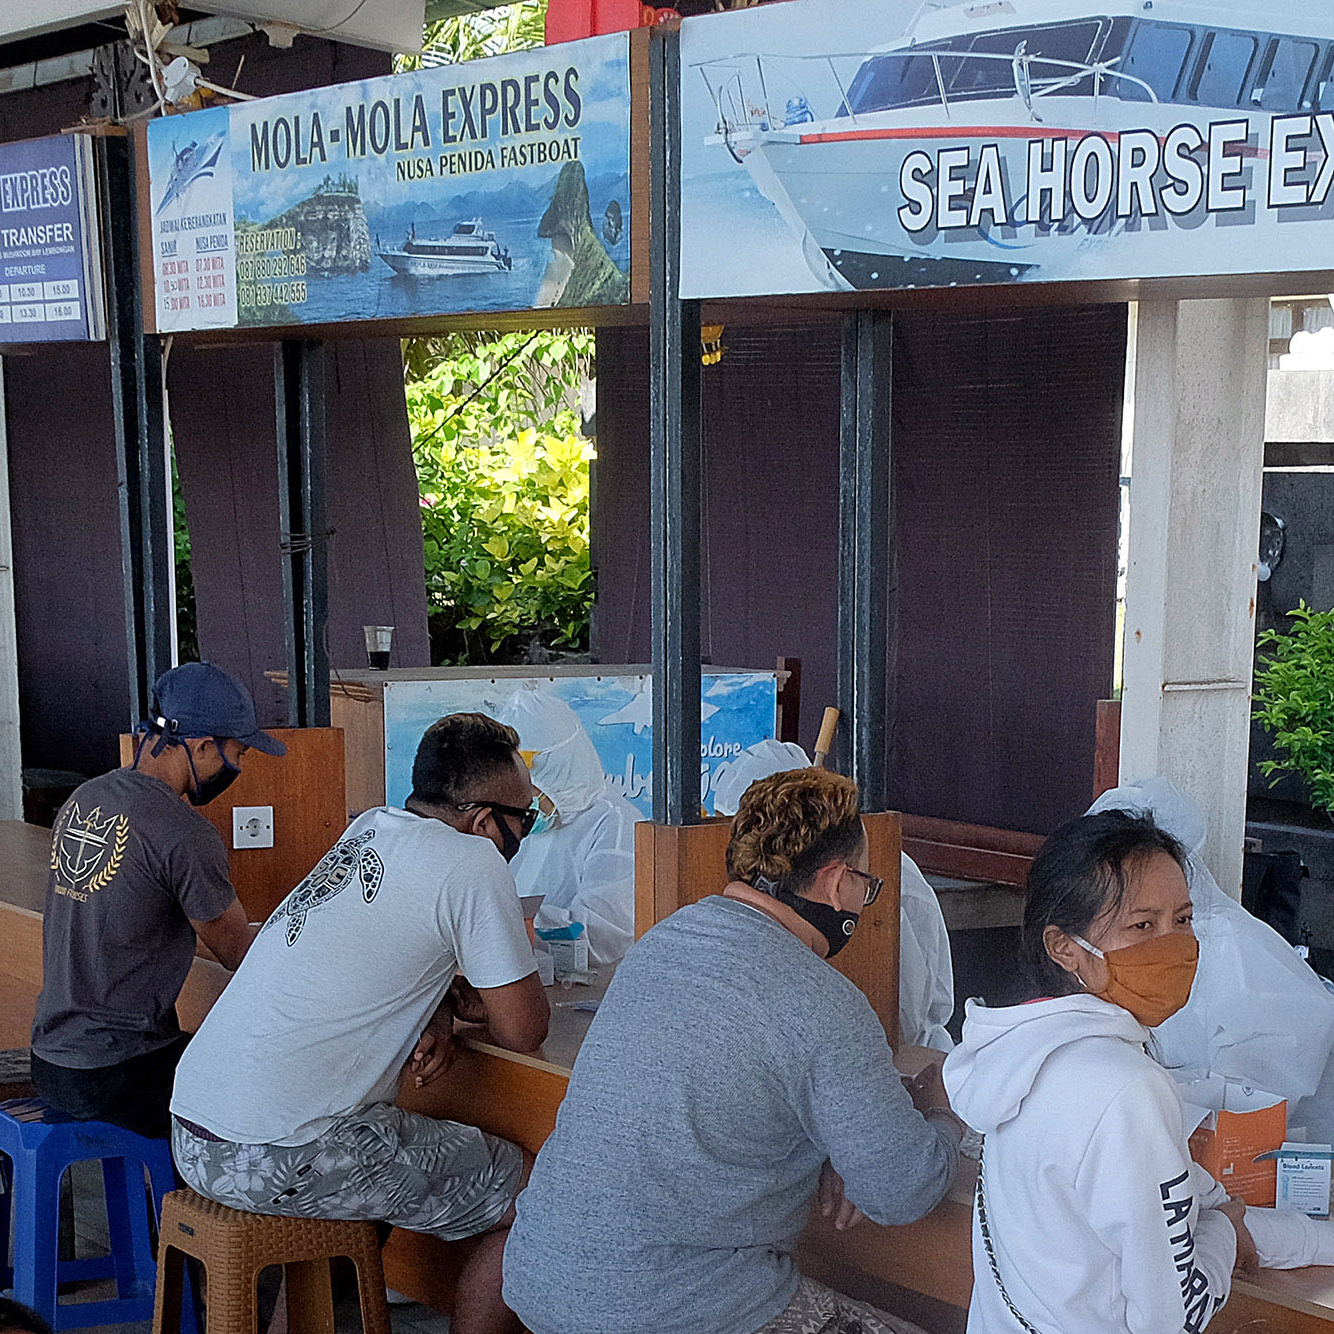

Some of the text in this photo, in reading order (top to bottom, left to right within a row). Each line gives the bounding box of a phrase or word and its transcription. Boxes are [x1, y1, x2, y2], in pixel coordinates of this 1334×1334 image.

[249, 66, 583, 173] MOLA-MOLA EXPRESS
[396, 136, 582, 182] NUSA PENIDA FASTBOAT
[1, 166, 72, 212] EXPRESS
[897, 143, 1008, 234] SEA
[1026, 118, 1250, 222] HORSE
[2, 223, 74, 248] TRANSFER
[239, 228, 296, 254] RESERVATION
[4, 264, 46, 277] DEPARTURE
[240, 254, 307, 281] 087 880 292 646
[256, 284, 272, 305] 337
[273, 282, 289, 304] 442
[290, 281, 308, 303] 555
